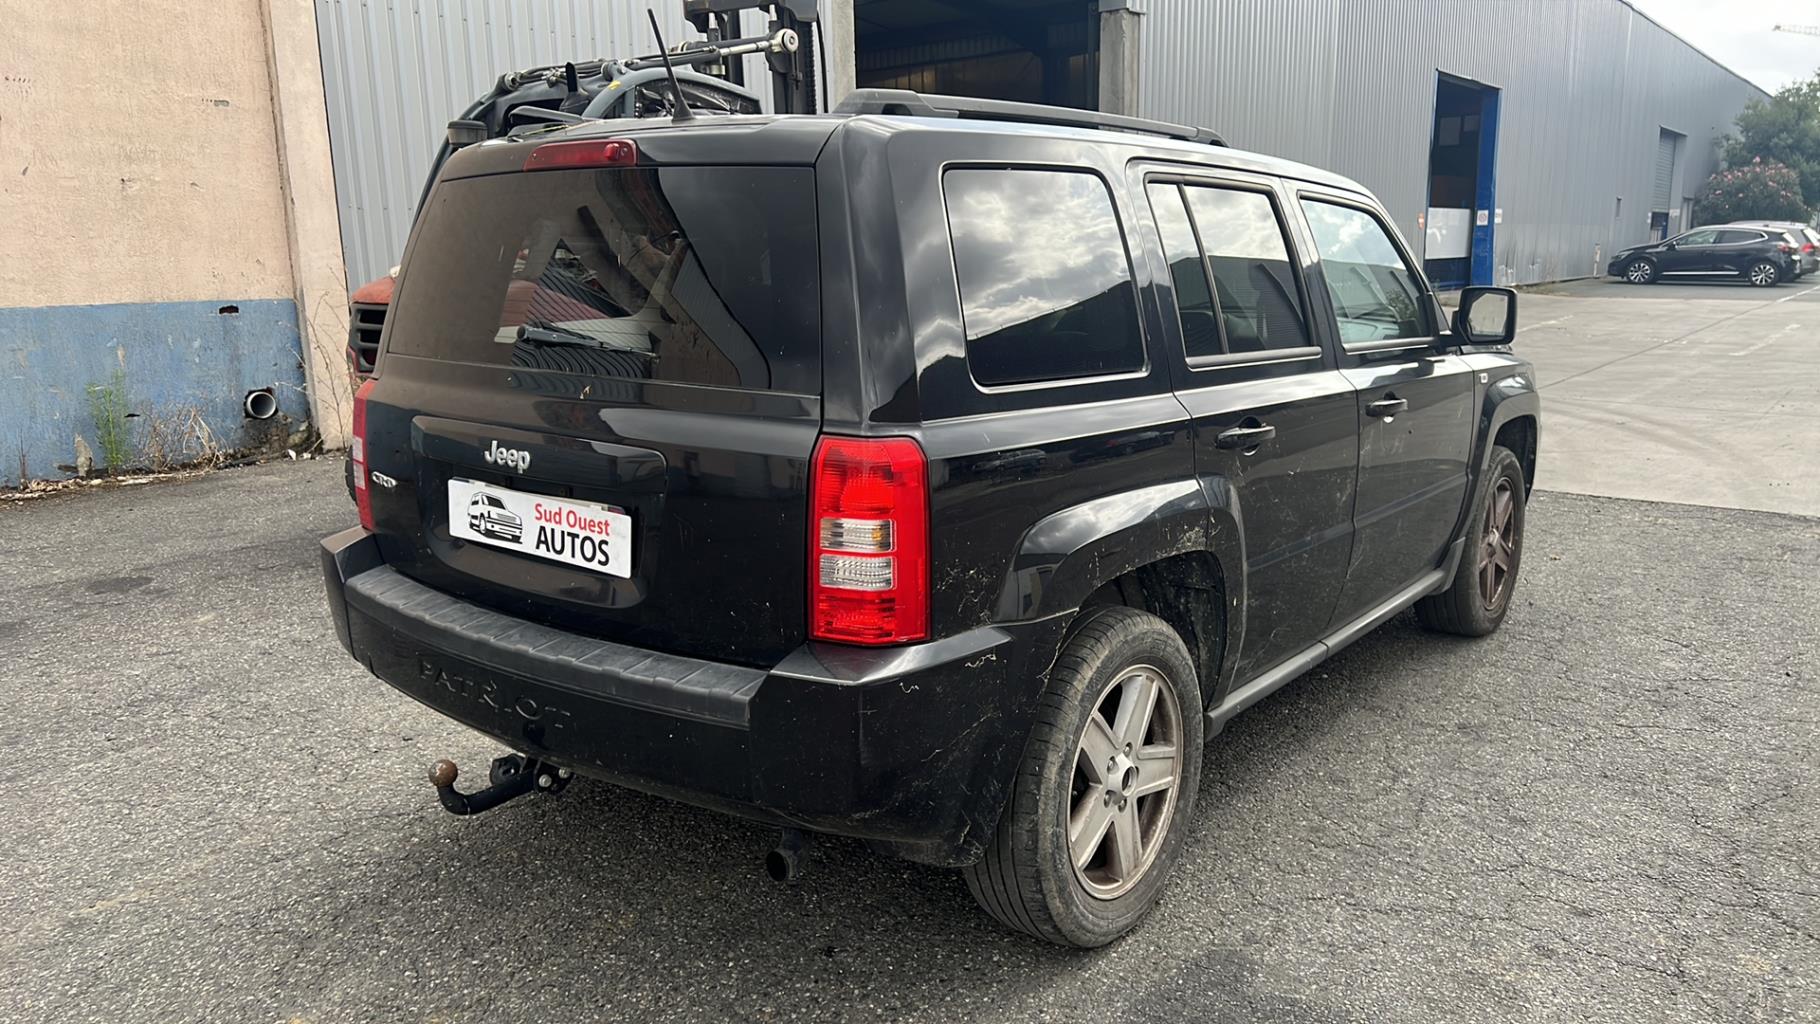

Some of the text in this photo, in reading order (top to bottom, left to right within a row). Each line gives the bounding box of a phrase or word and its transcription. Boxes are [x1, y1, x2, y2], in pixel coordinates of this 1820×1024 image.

[484, 440, 531, 473] Jeep
[534, 503, 610, 536] Sud Ouest
[535, 525, 610, 566] AUTOS
